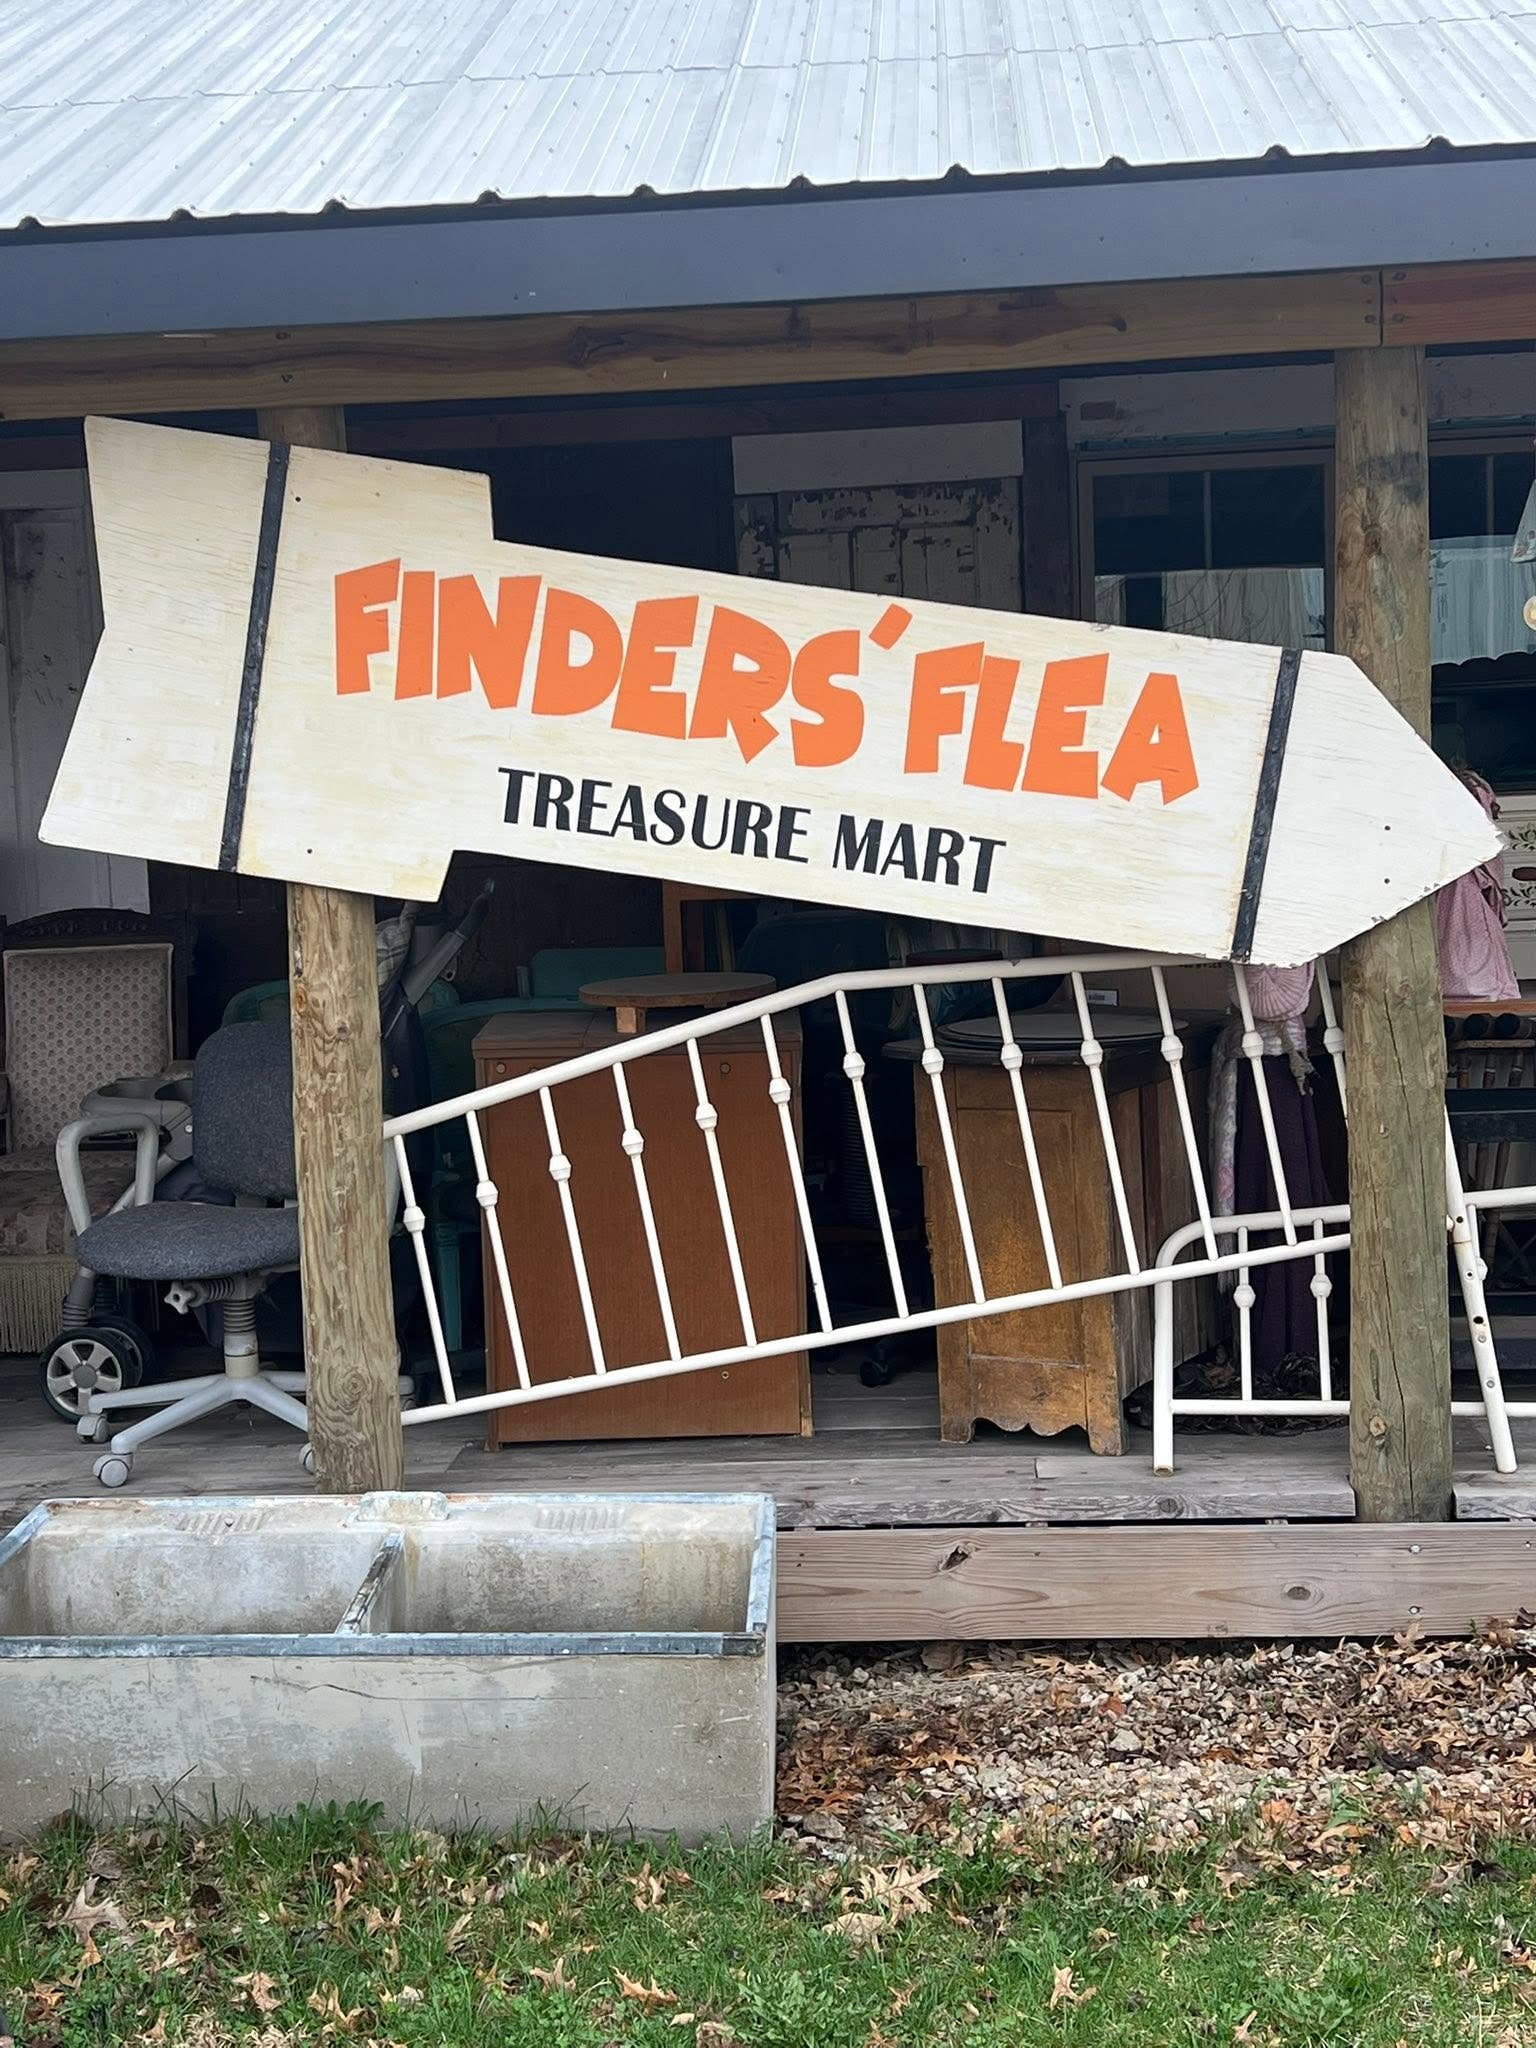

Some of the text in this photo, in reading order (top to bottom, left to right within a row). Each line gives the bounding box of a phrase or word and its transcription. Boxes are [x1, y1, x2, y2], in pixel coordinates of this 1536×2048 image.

[335, 560, 1198, 802] FINDERS' FLEA
[498, 767, 1007, 894] TREASURE MART
